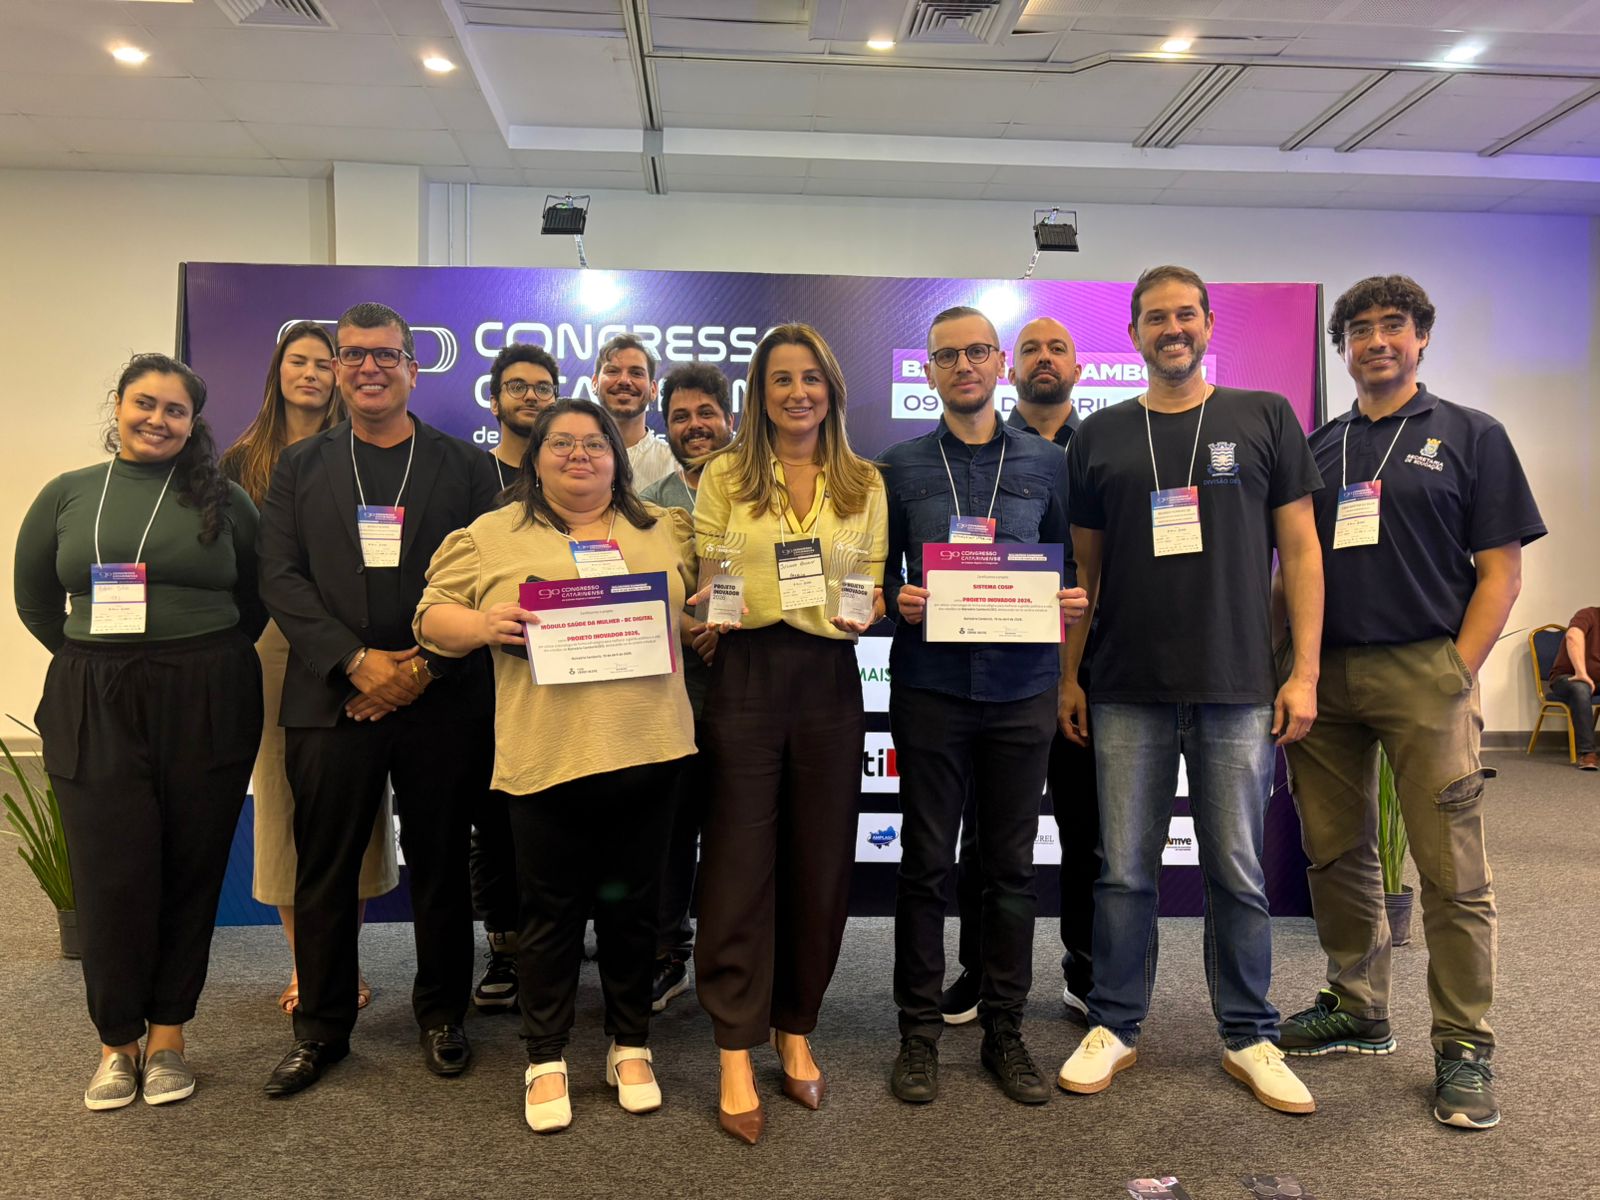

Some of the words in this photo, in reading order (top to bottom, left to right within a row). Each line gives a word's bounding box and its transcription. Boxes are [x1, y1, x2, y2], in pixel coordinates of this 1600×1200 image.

[474, 321, 775, 364] CONRESS
[903, 395, 939, 411] 09
[473, 426, 499, 444] de
